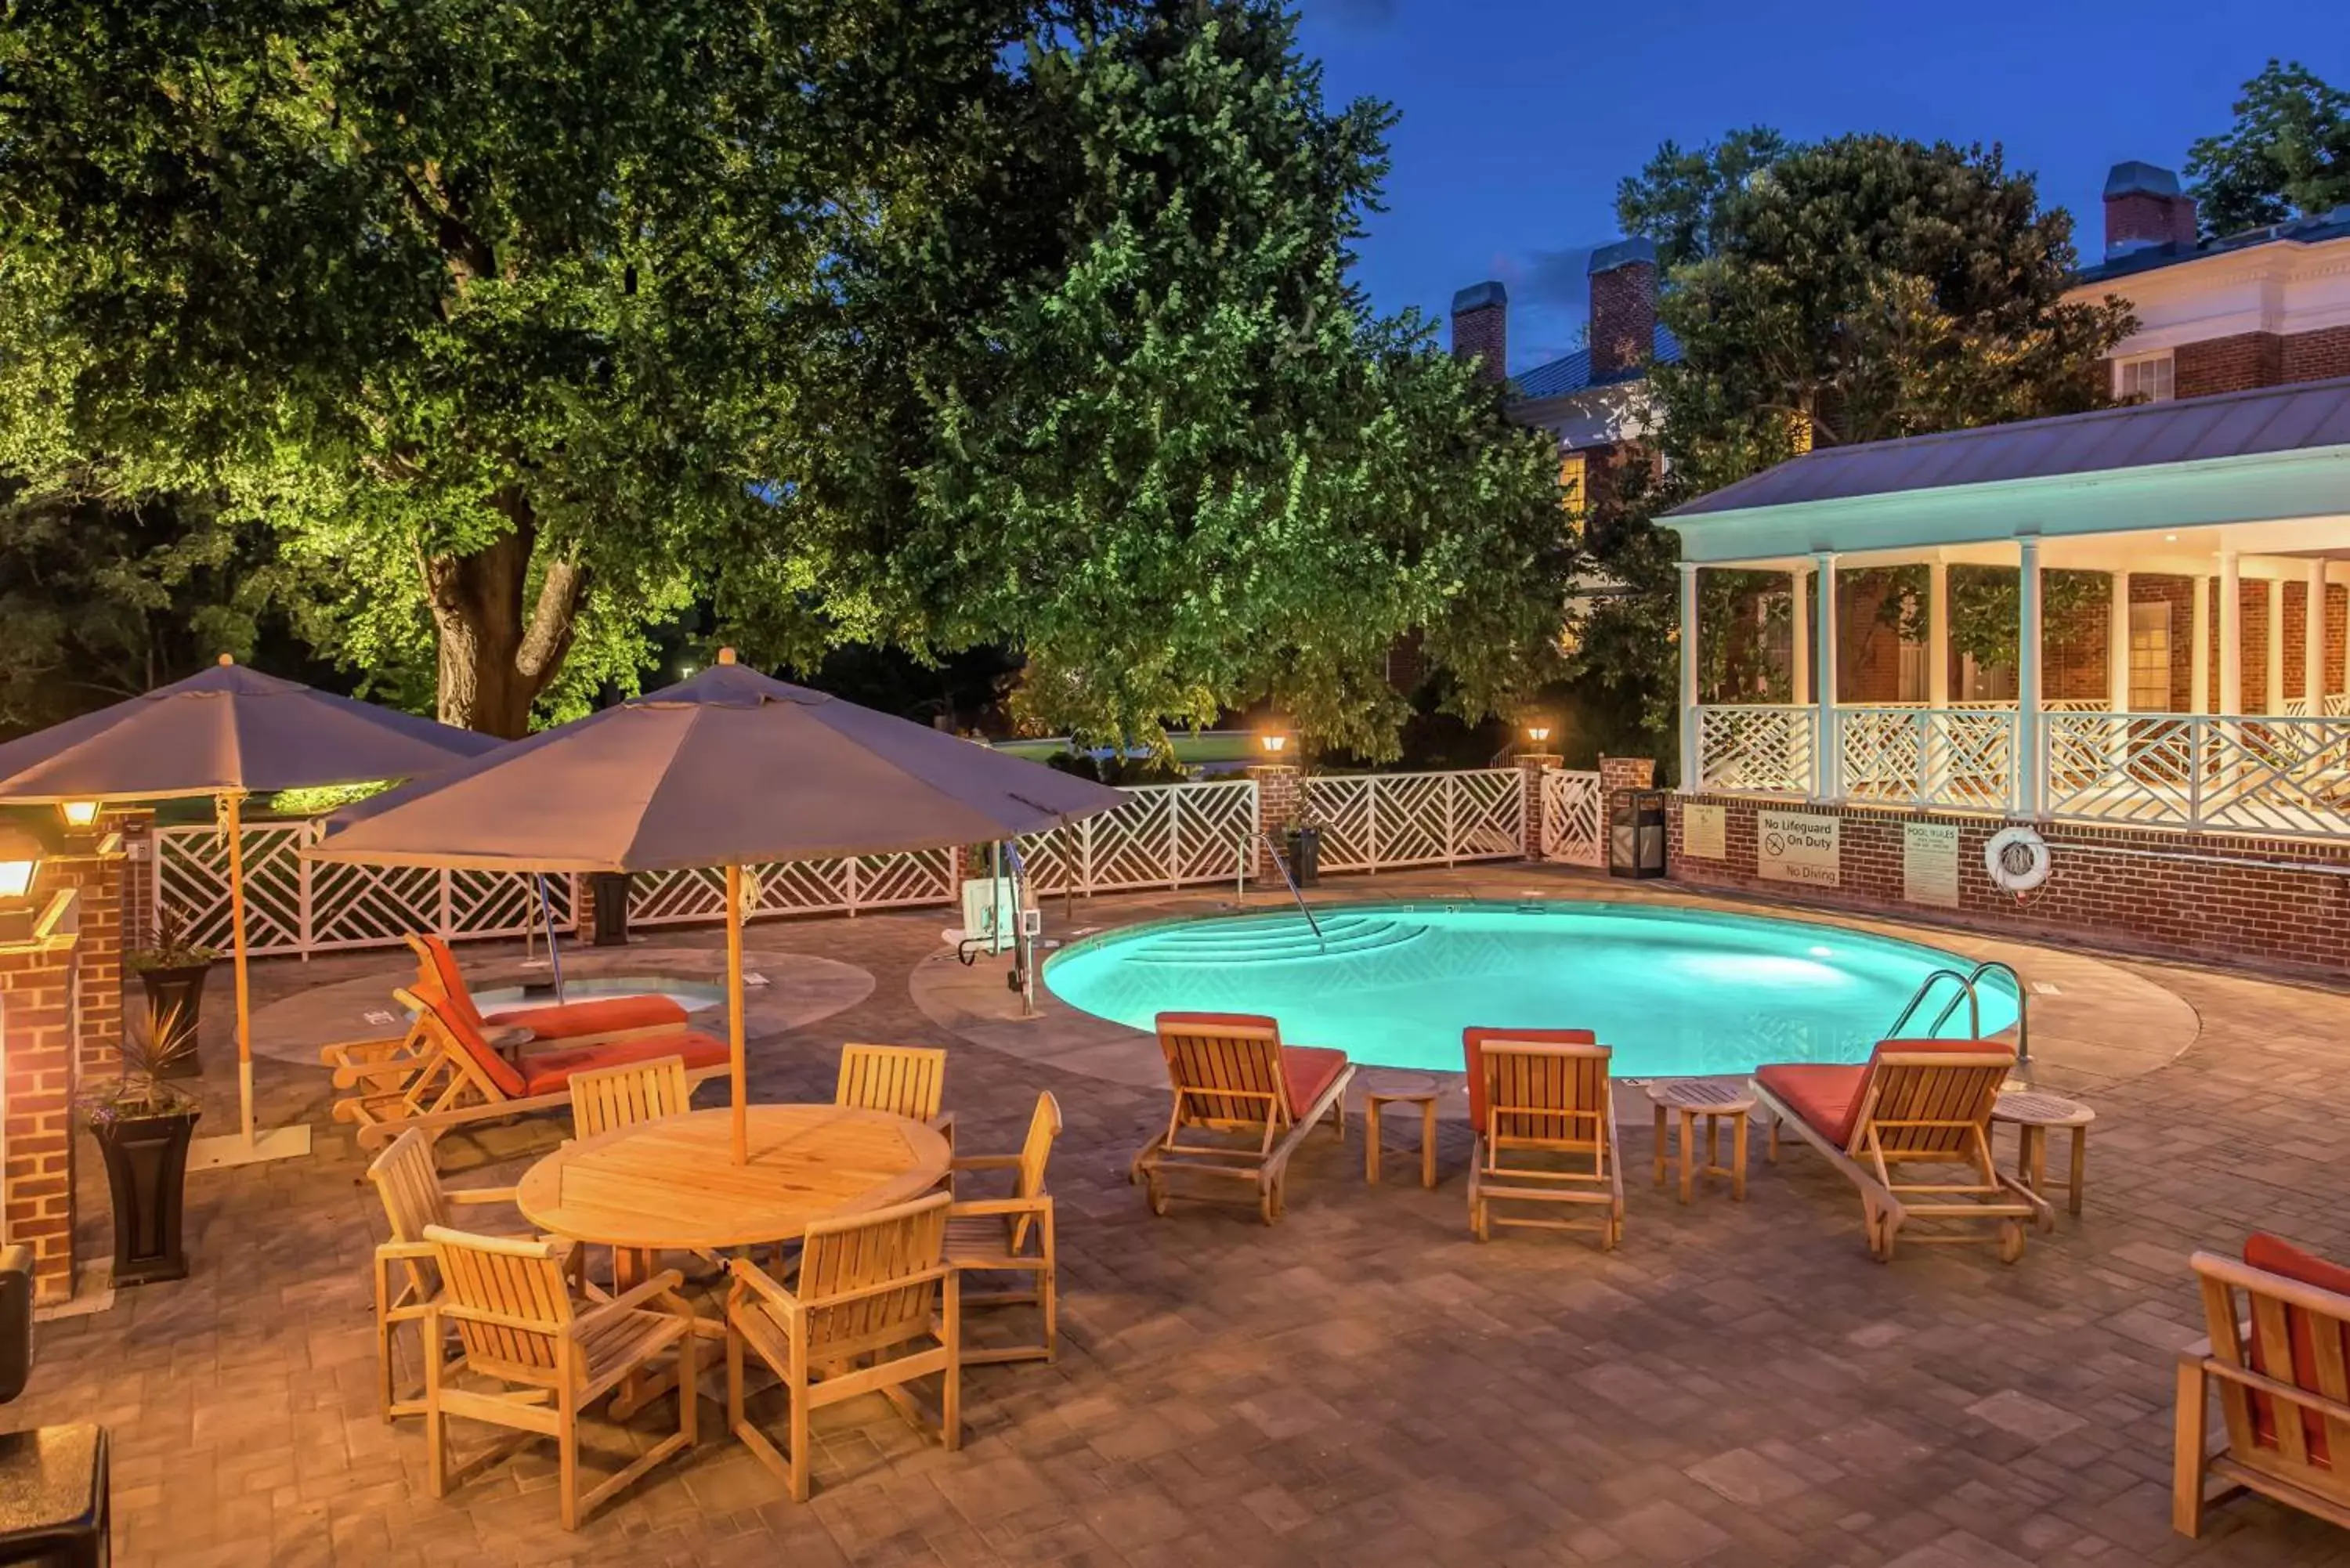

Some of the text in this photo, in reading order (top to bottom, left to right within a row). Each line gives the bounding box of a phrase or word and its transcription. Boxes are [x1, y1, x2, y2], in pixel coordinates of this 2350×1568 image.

[1765, 818, 1831, 834] No Lifeguard
[1788, 834, 1831, 851] On Duty
[1787, 865, 1835, 883] No Diving
